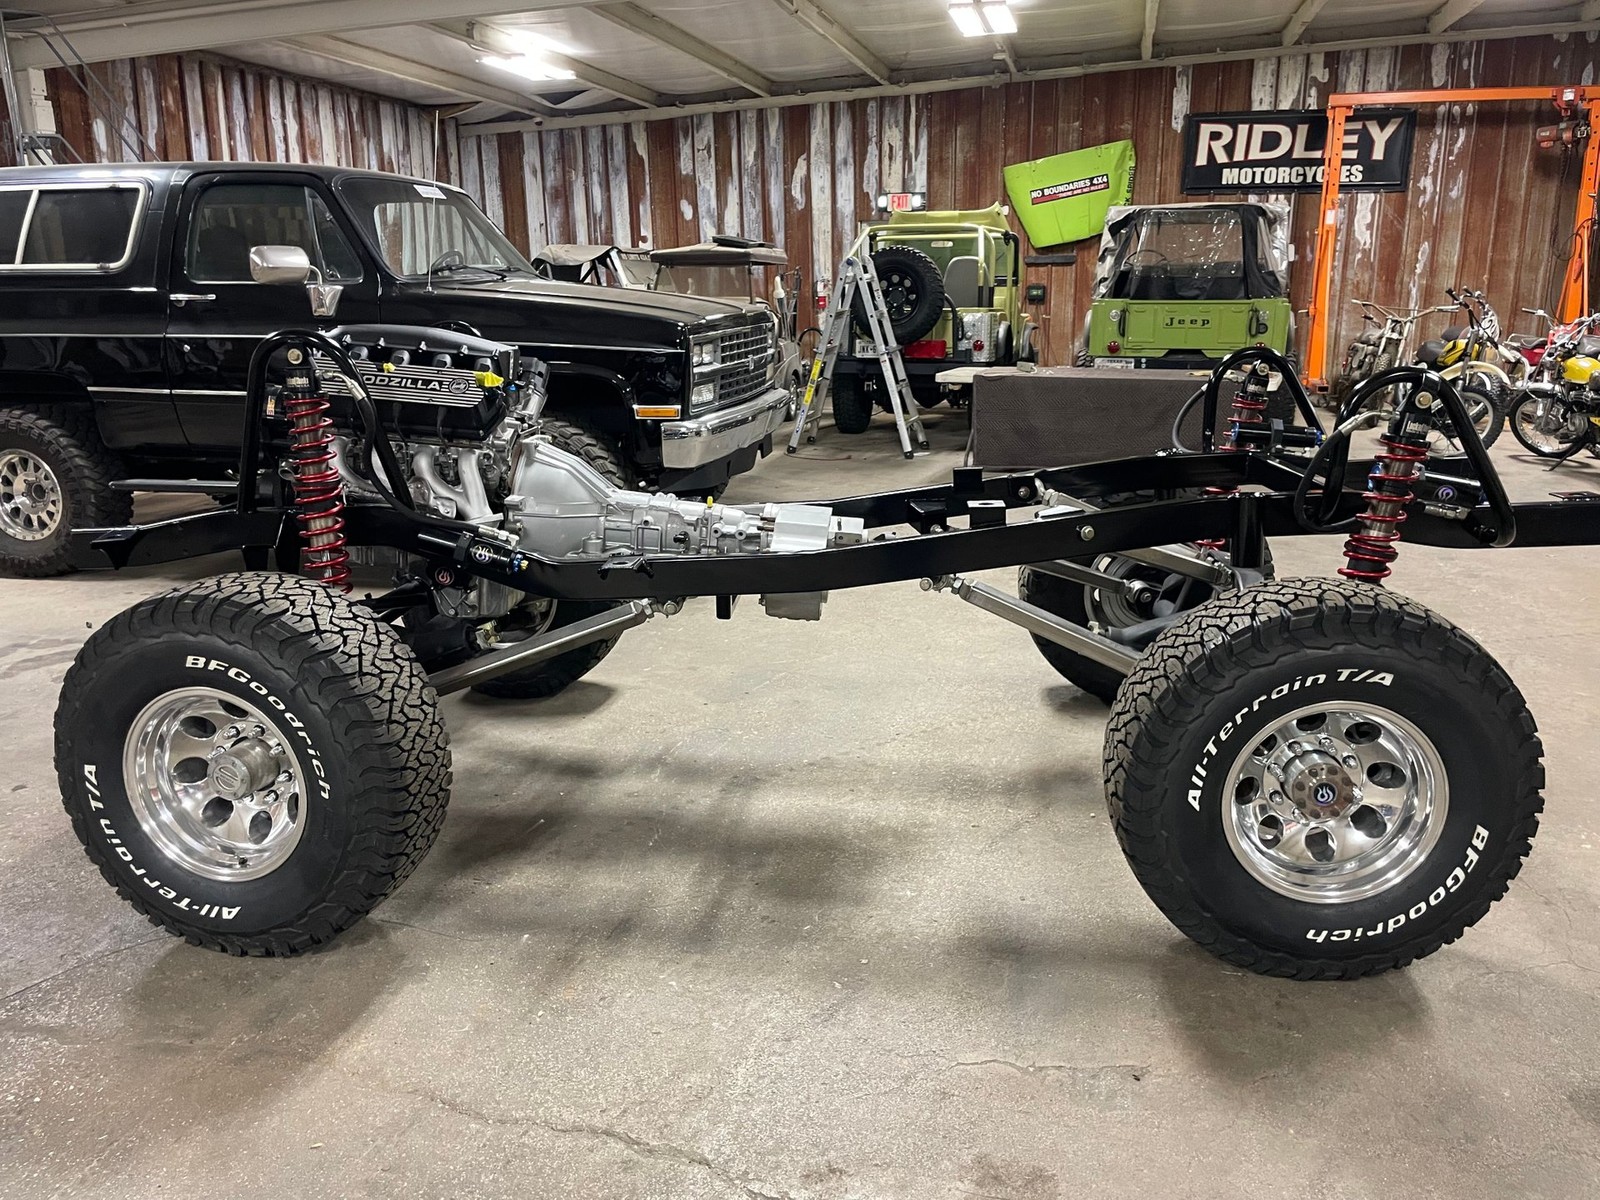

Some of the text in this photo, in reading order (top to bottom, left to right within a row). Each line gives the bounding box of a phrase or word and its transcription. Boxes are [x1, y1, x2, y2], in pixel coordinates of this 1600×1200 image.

[1194, 117, 1405, 167] RIDLEY
[1031, 176, 1108, 198] NO BOUNDARIES 4X4
[1221, 164, 1364, 185] MOTORCYCES
[891, 195, 909, 209] EXIT
[1165, 317, 1211, 327] Jeep
[363, 374, 441, 391] ODZILLA
[185, 655, 332, 800] BFGoodrich
[1187, 668, 1395, 812] All-Terrain T/A
[84, 764, 242, 920] All-Terrain T/A
[1305, 824, 1490, 943] BFGoodrich
